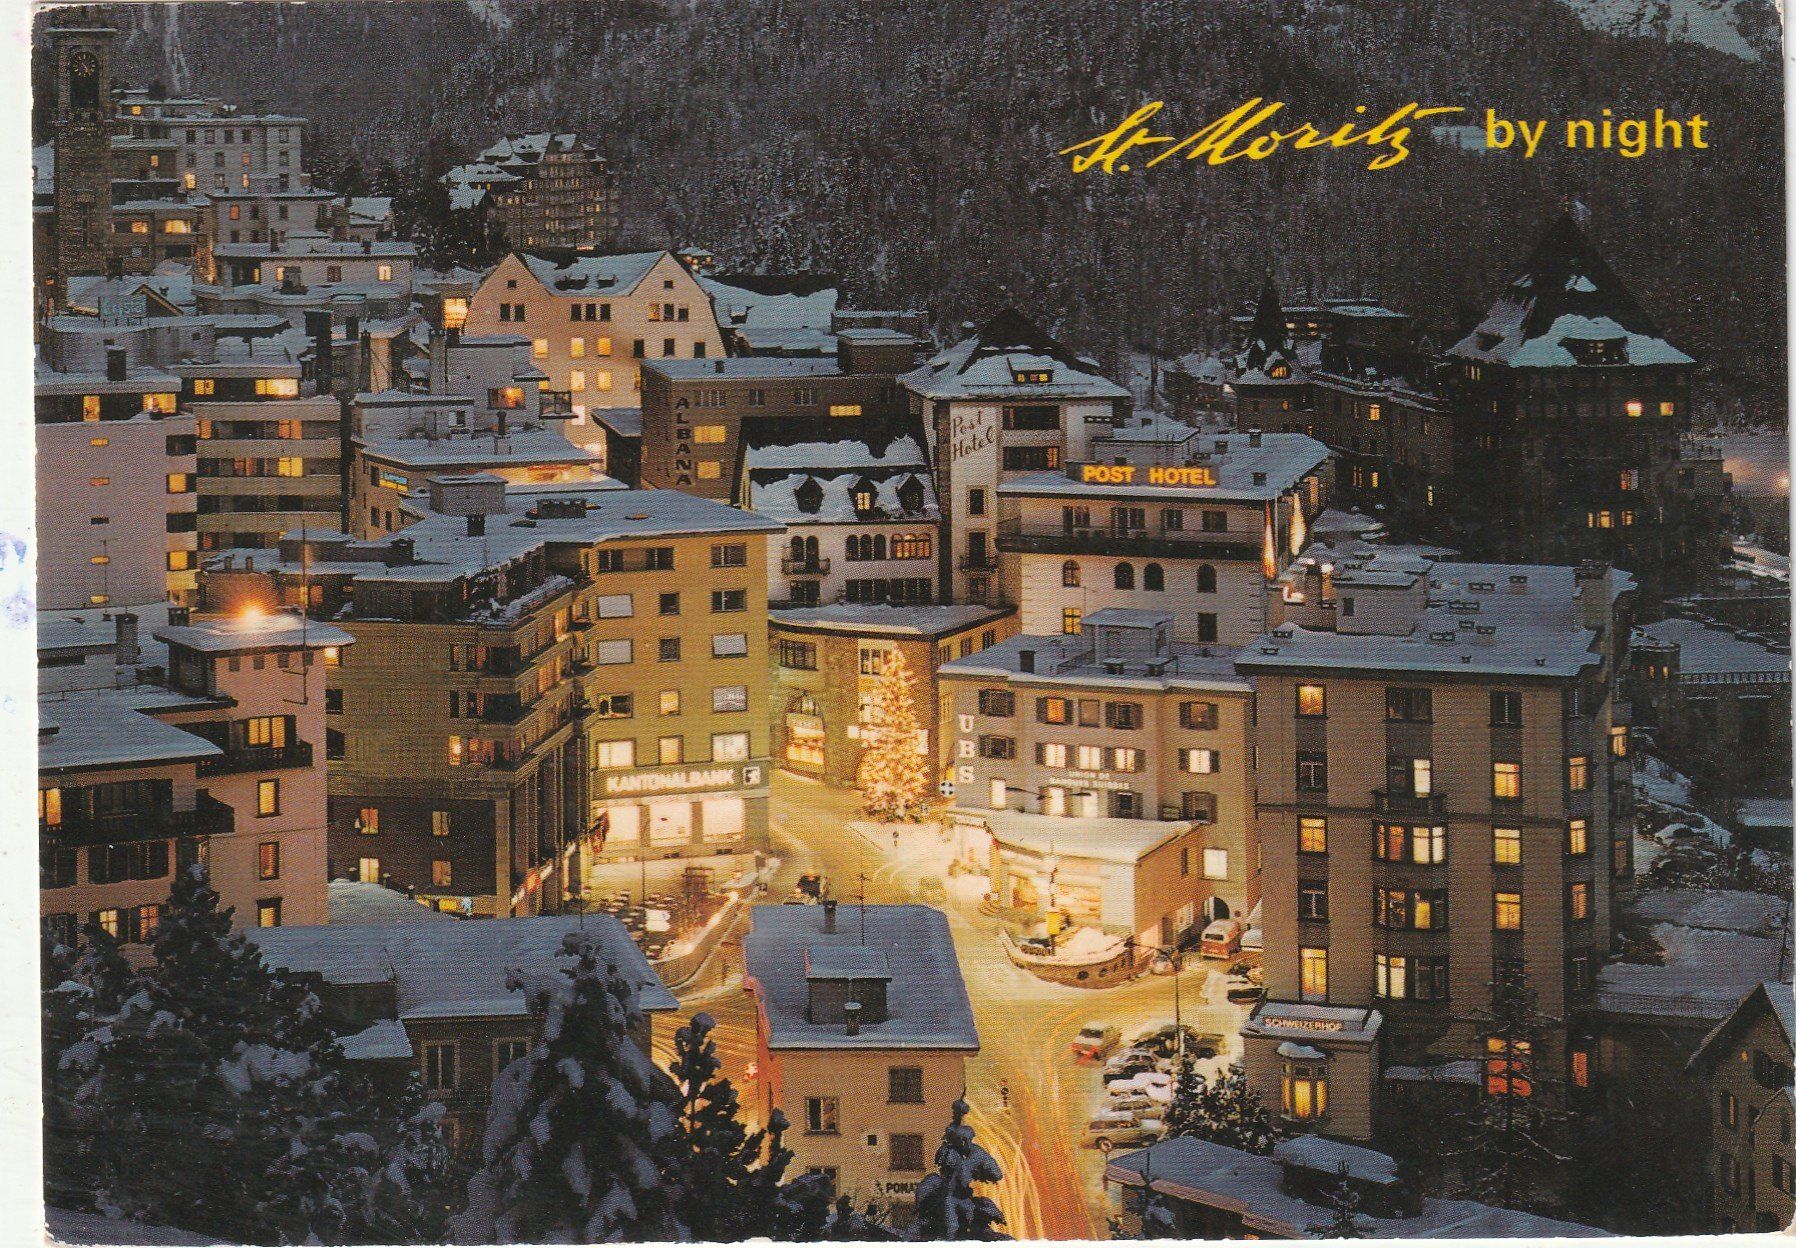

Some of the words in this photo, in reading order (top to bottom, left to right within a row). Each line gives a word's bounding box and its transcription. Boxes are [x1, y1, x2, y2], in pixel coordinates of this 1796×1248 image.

[952, 409, 984, 439] Post
[675, 397, 694, 486] ALBANA
[952, 425, 994, 461] Hotel
[1082, 465, 1137, 483] POST
[1148, 467, 1218, 486] HOTEL
[957, 714, 976, 784] UBS
[606, 769, 735, 792] KANTONALBANK
[1265, 1018, 1343, 1031] SCHWEIZERHOF
